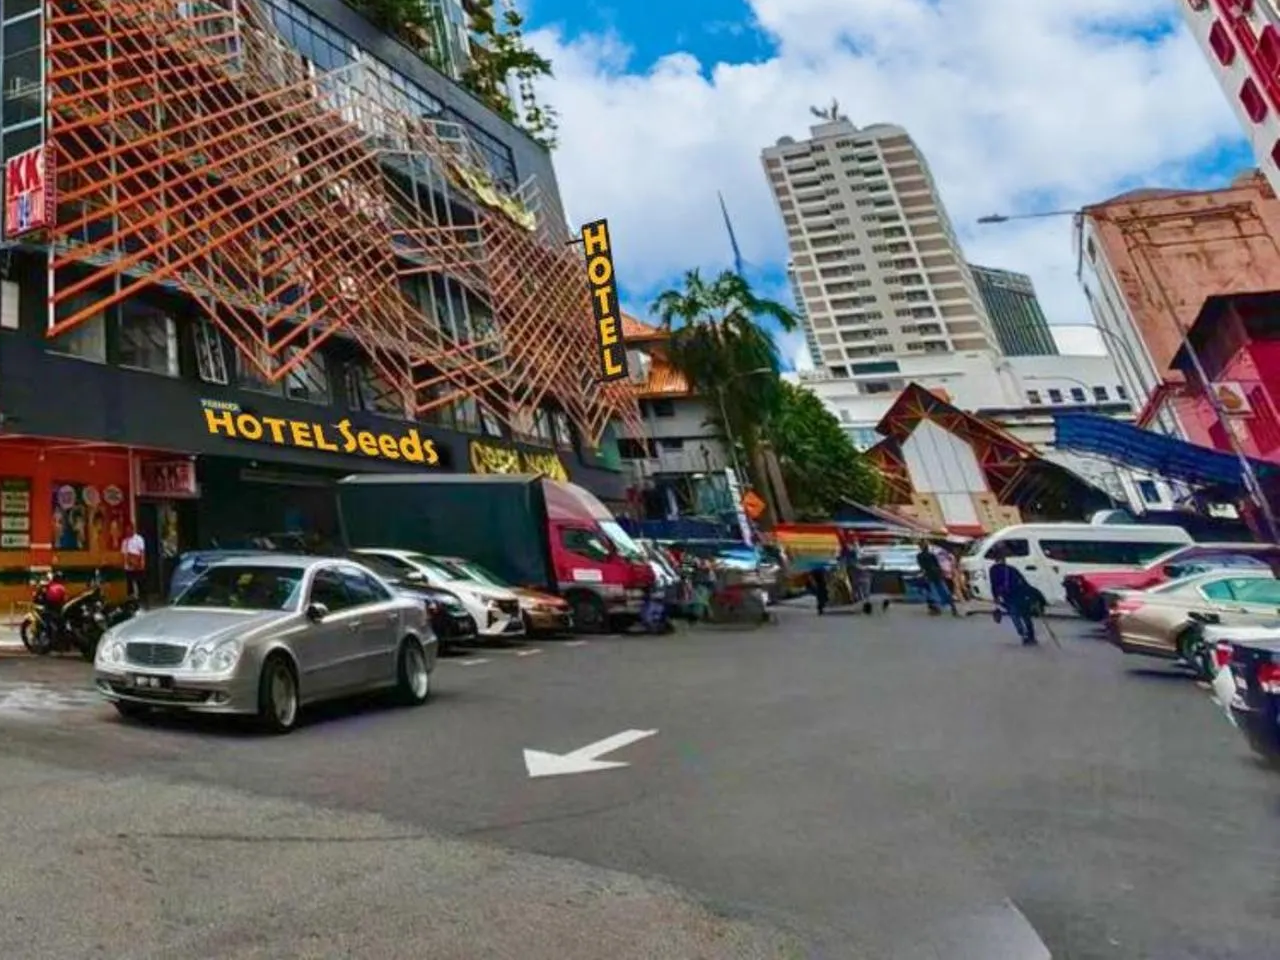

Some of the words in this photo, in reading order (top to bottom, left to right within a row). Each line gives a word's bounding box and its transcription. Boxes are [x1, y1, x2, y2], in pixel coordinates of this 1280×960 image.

[9, 150, 41, 197] KK
[582, 223, 623, 377] HOTEL
[203, 408, 339, 453] HOTEL
[332, 419, 441, 465] Seeds
